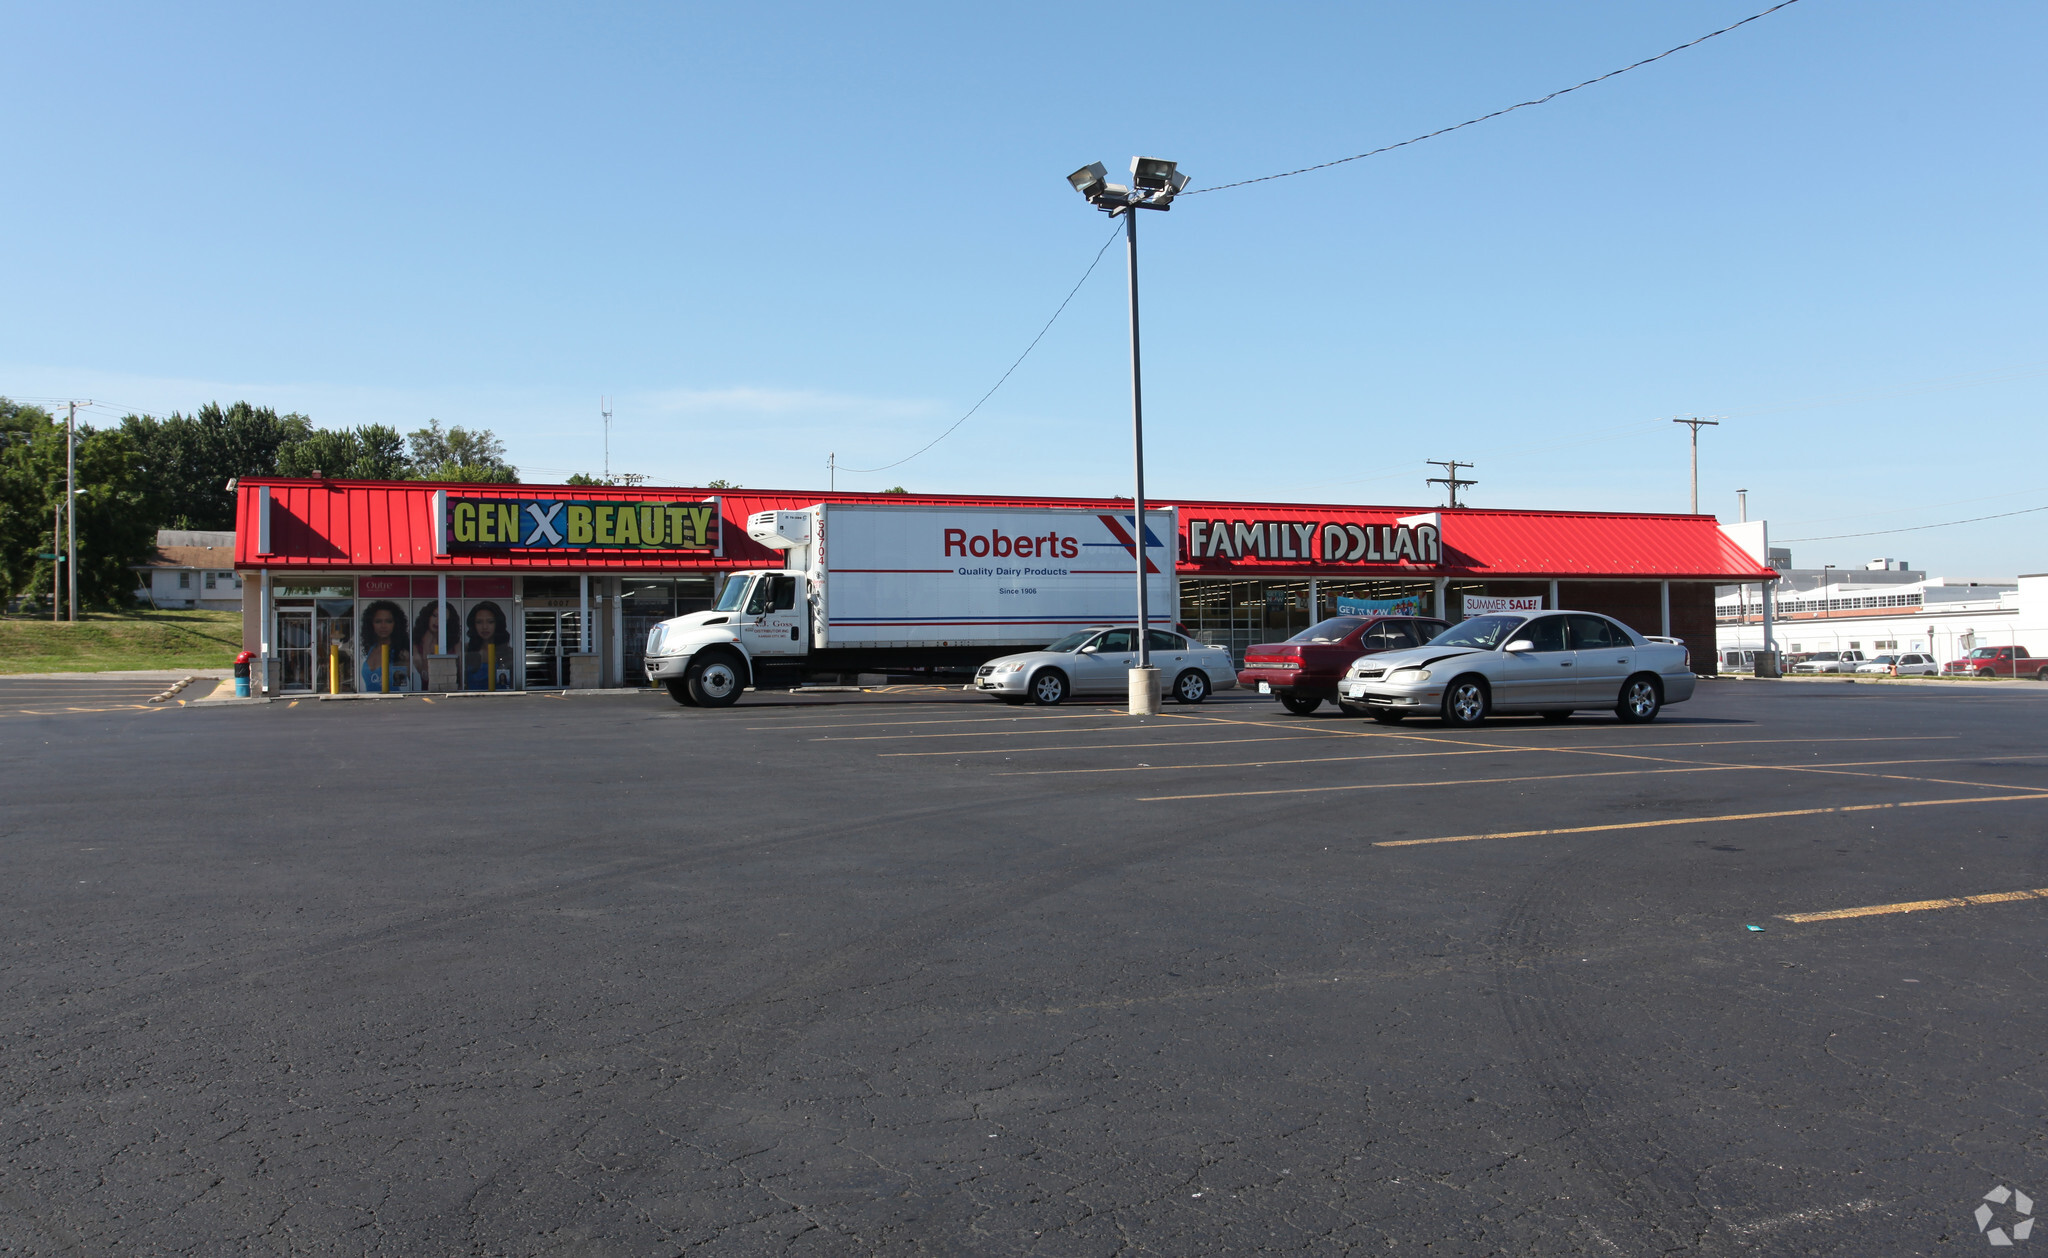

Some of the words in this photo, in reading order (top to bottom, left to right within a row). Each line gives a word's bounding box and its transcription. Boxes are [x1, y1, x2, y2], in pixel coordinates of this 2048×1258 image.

[453, 502, 519, 543] GEN
[524, 501, 565, 546] X
[567, 505, 713, 546] BEAUTY
[944, 528, 1079, 559] Roberts
[1190, 520, 1317, 559] FAMILY
[1323, 524, 1438, 562] DOLLAR
[958, 567, 993, 577] Quality
[996, 567, 1021, 577] Dairy
[1024, 567, 1067, 576] Products
[999, 587, 1019, 595] Since
[1021, 587, 1037, 595] 1906
[1466, 598, 1507, 610] SUMMER
[1509, 599, 1537, 610] SALE!
[1338, 605, 1355, 614] GET
[1366, 608, 1389, 616] NOW
